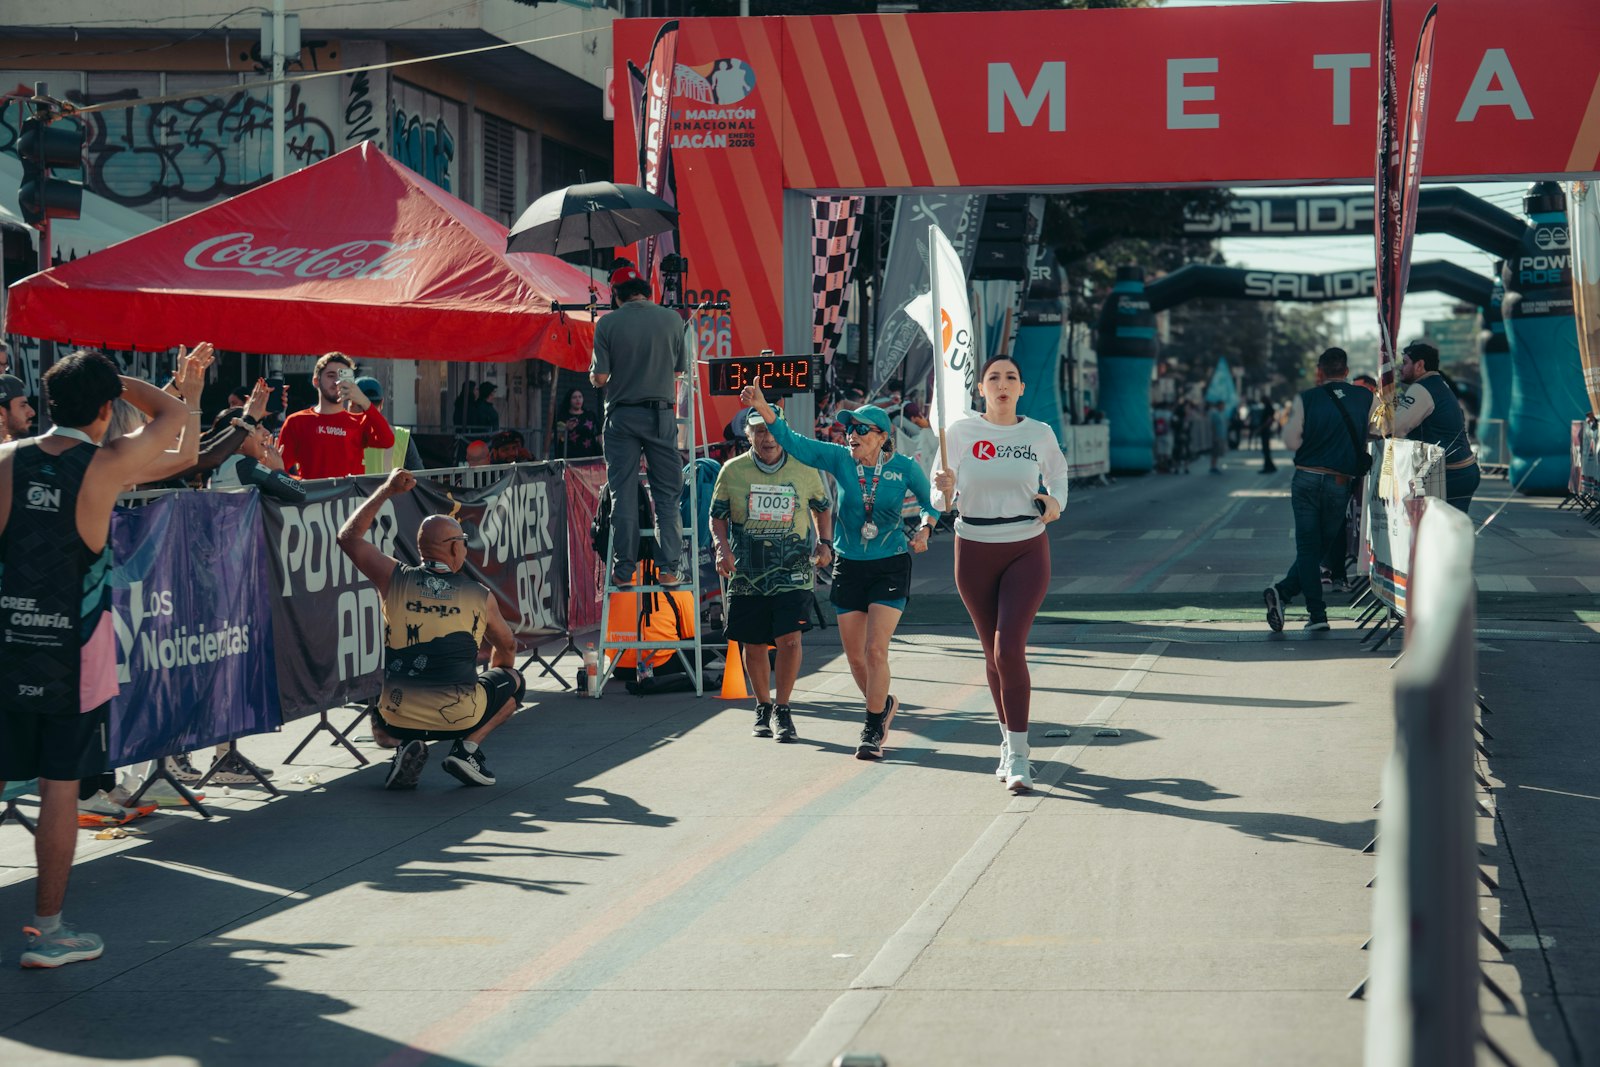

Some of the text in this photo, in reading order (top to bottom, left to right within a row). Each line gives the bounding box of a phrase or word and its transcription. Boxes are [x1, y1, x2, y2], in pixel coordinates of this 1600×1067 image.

[988, 48, 1534, 132] META
[686, 107, 756, 120] MARATÓN
[671, 122, 755, 130] RNACIONAL
[671, 132, 727, 148] IACÁN
[728, 139, 755, 148] 2026
[183, 232, 430, 281] Coca-Cola
[27, 486, 61, 508] ON
[757, 495, 790, 510] 1003
[479, 481, 554, 568] POWER
[514, 555, 553, 634] ADE
[11, 612, 73, 629] CONFÍA.
[338, 588, 385, 681] AD
